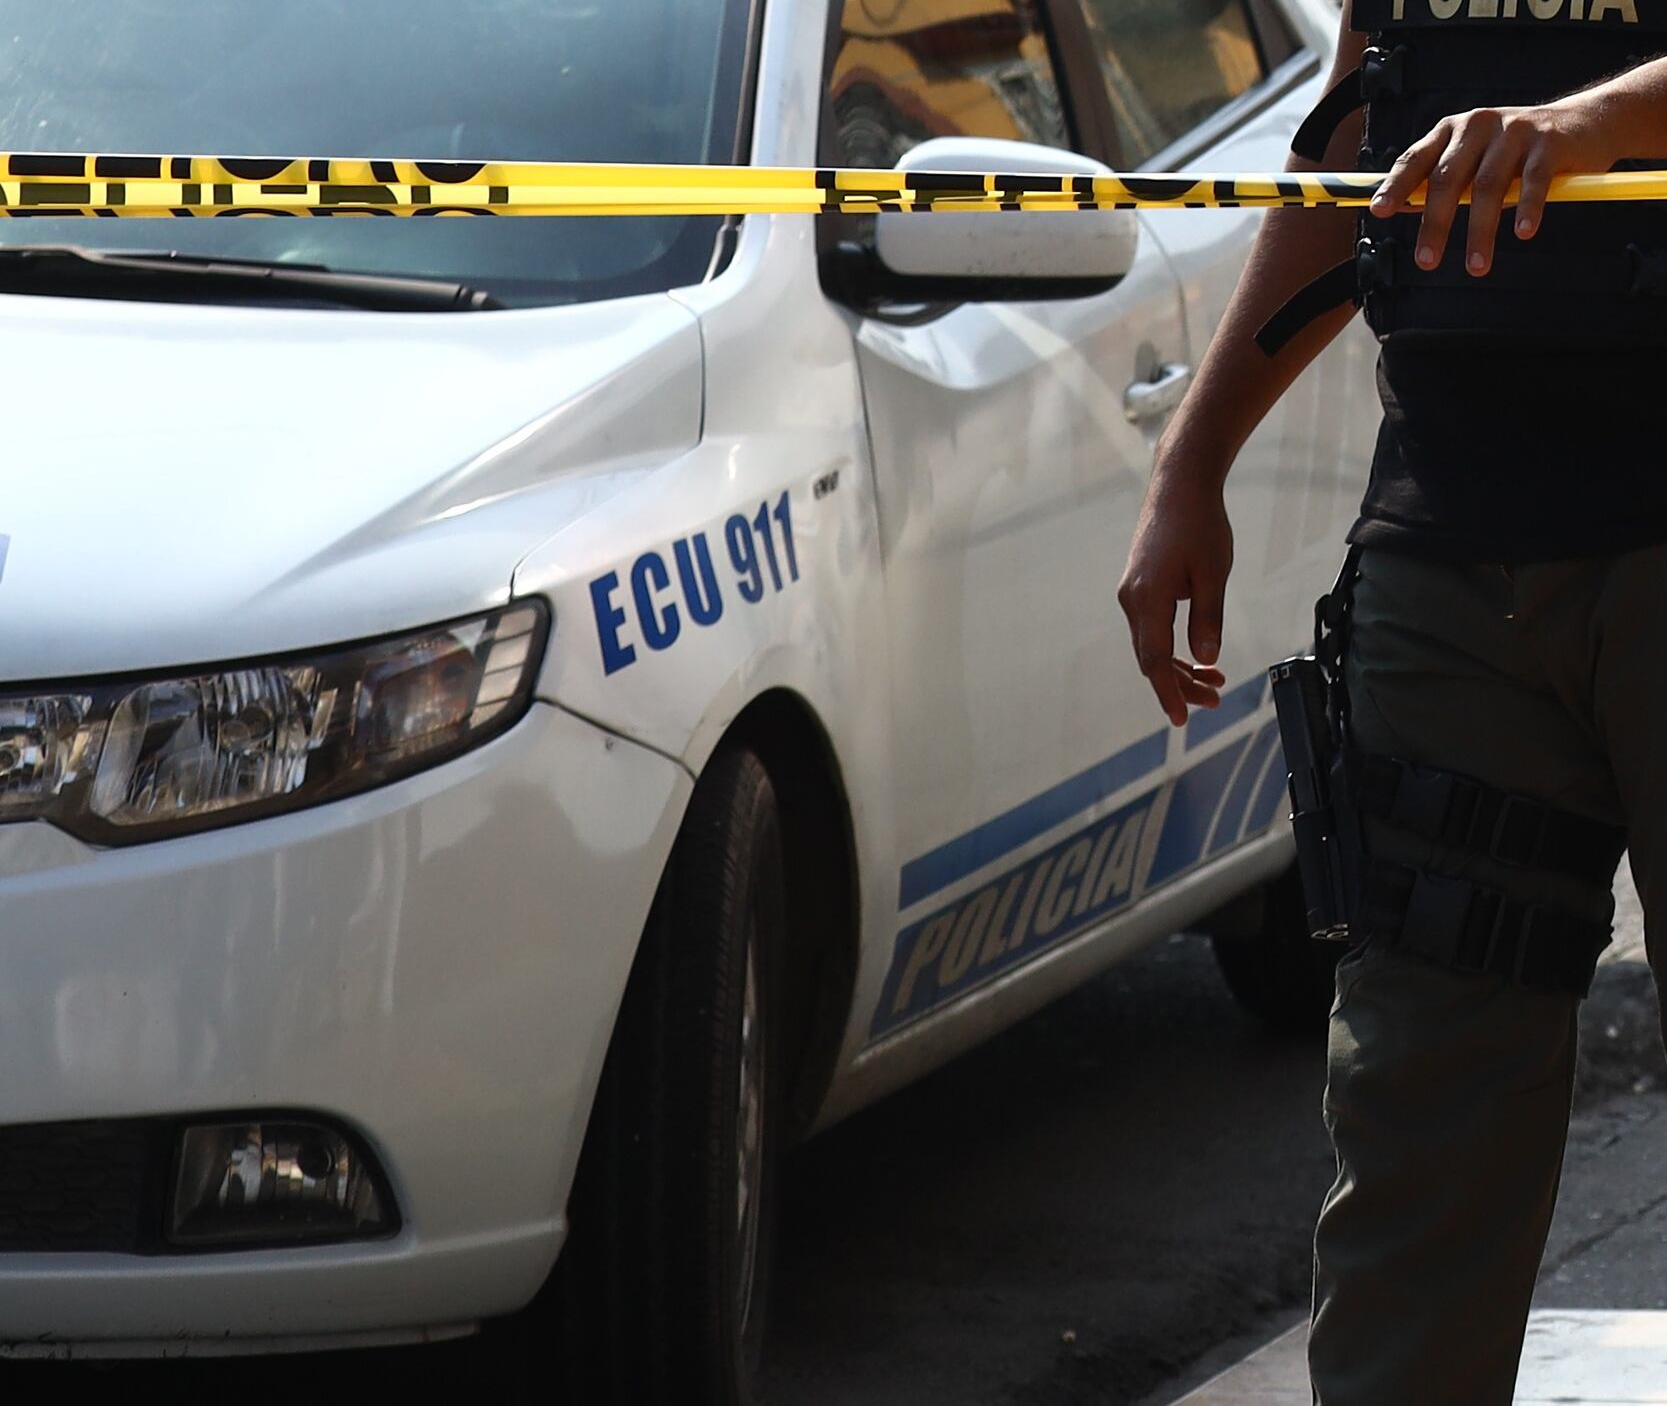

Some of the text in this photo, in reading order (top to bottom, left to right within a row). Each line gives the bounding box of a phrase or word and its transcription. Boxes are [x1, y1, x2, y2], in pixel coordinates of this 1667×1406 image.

[589, 489, 799, 677] ECU 911
[892, 806, 1148, 1016] POLICIA
